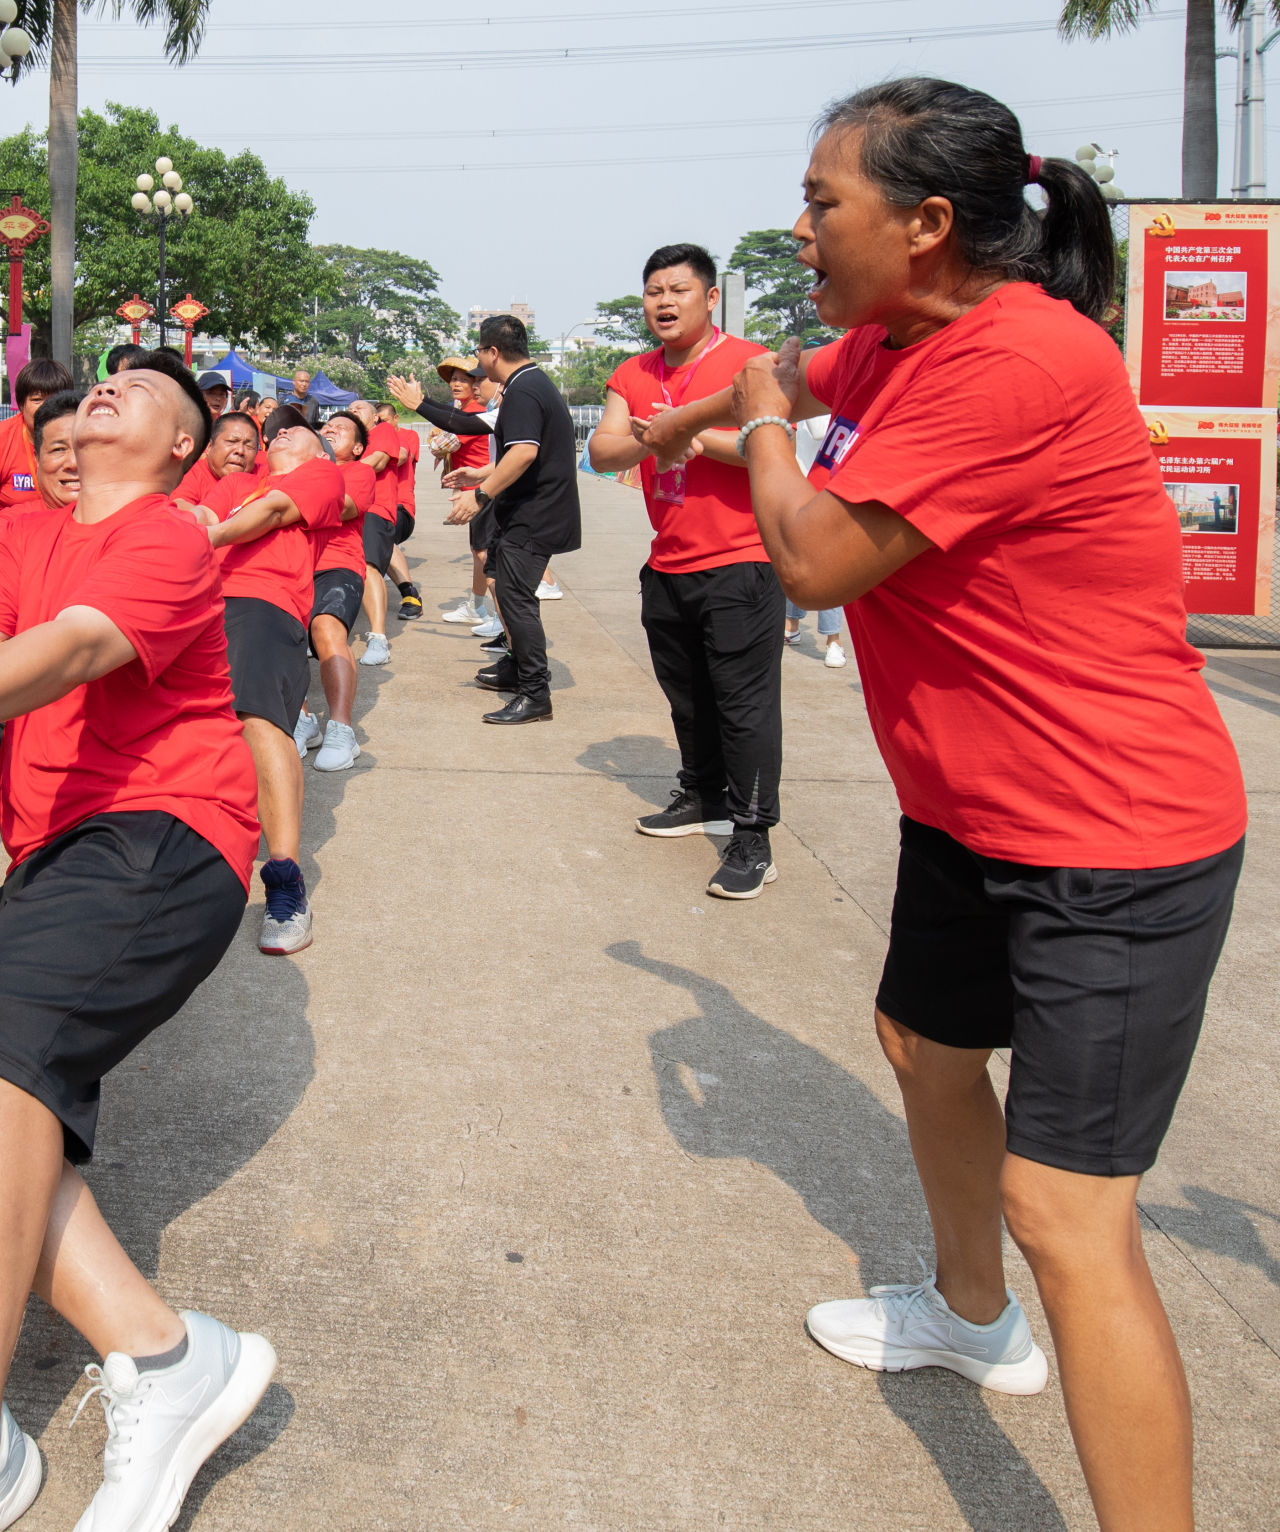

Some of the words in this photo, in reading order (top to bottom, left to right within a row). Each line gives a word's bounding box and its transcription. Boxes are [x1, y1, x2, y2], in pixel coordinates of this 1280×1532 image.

[1165, 246, 1240, 254] 中国共产党第三次全国
[1165, 255, 1233, 263] 代表大会在广州召开
[1159, 457, 1234, 465] 毛泽东主办第六届广州
[1160, 466, 1211, 474] 农民运动讲习所
